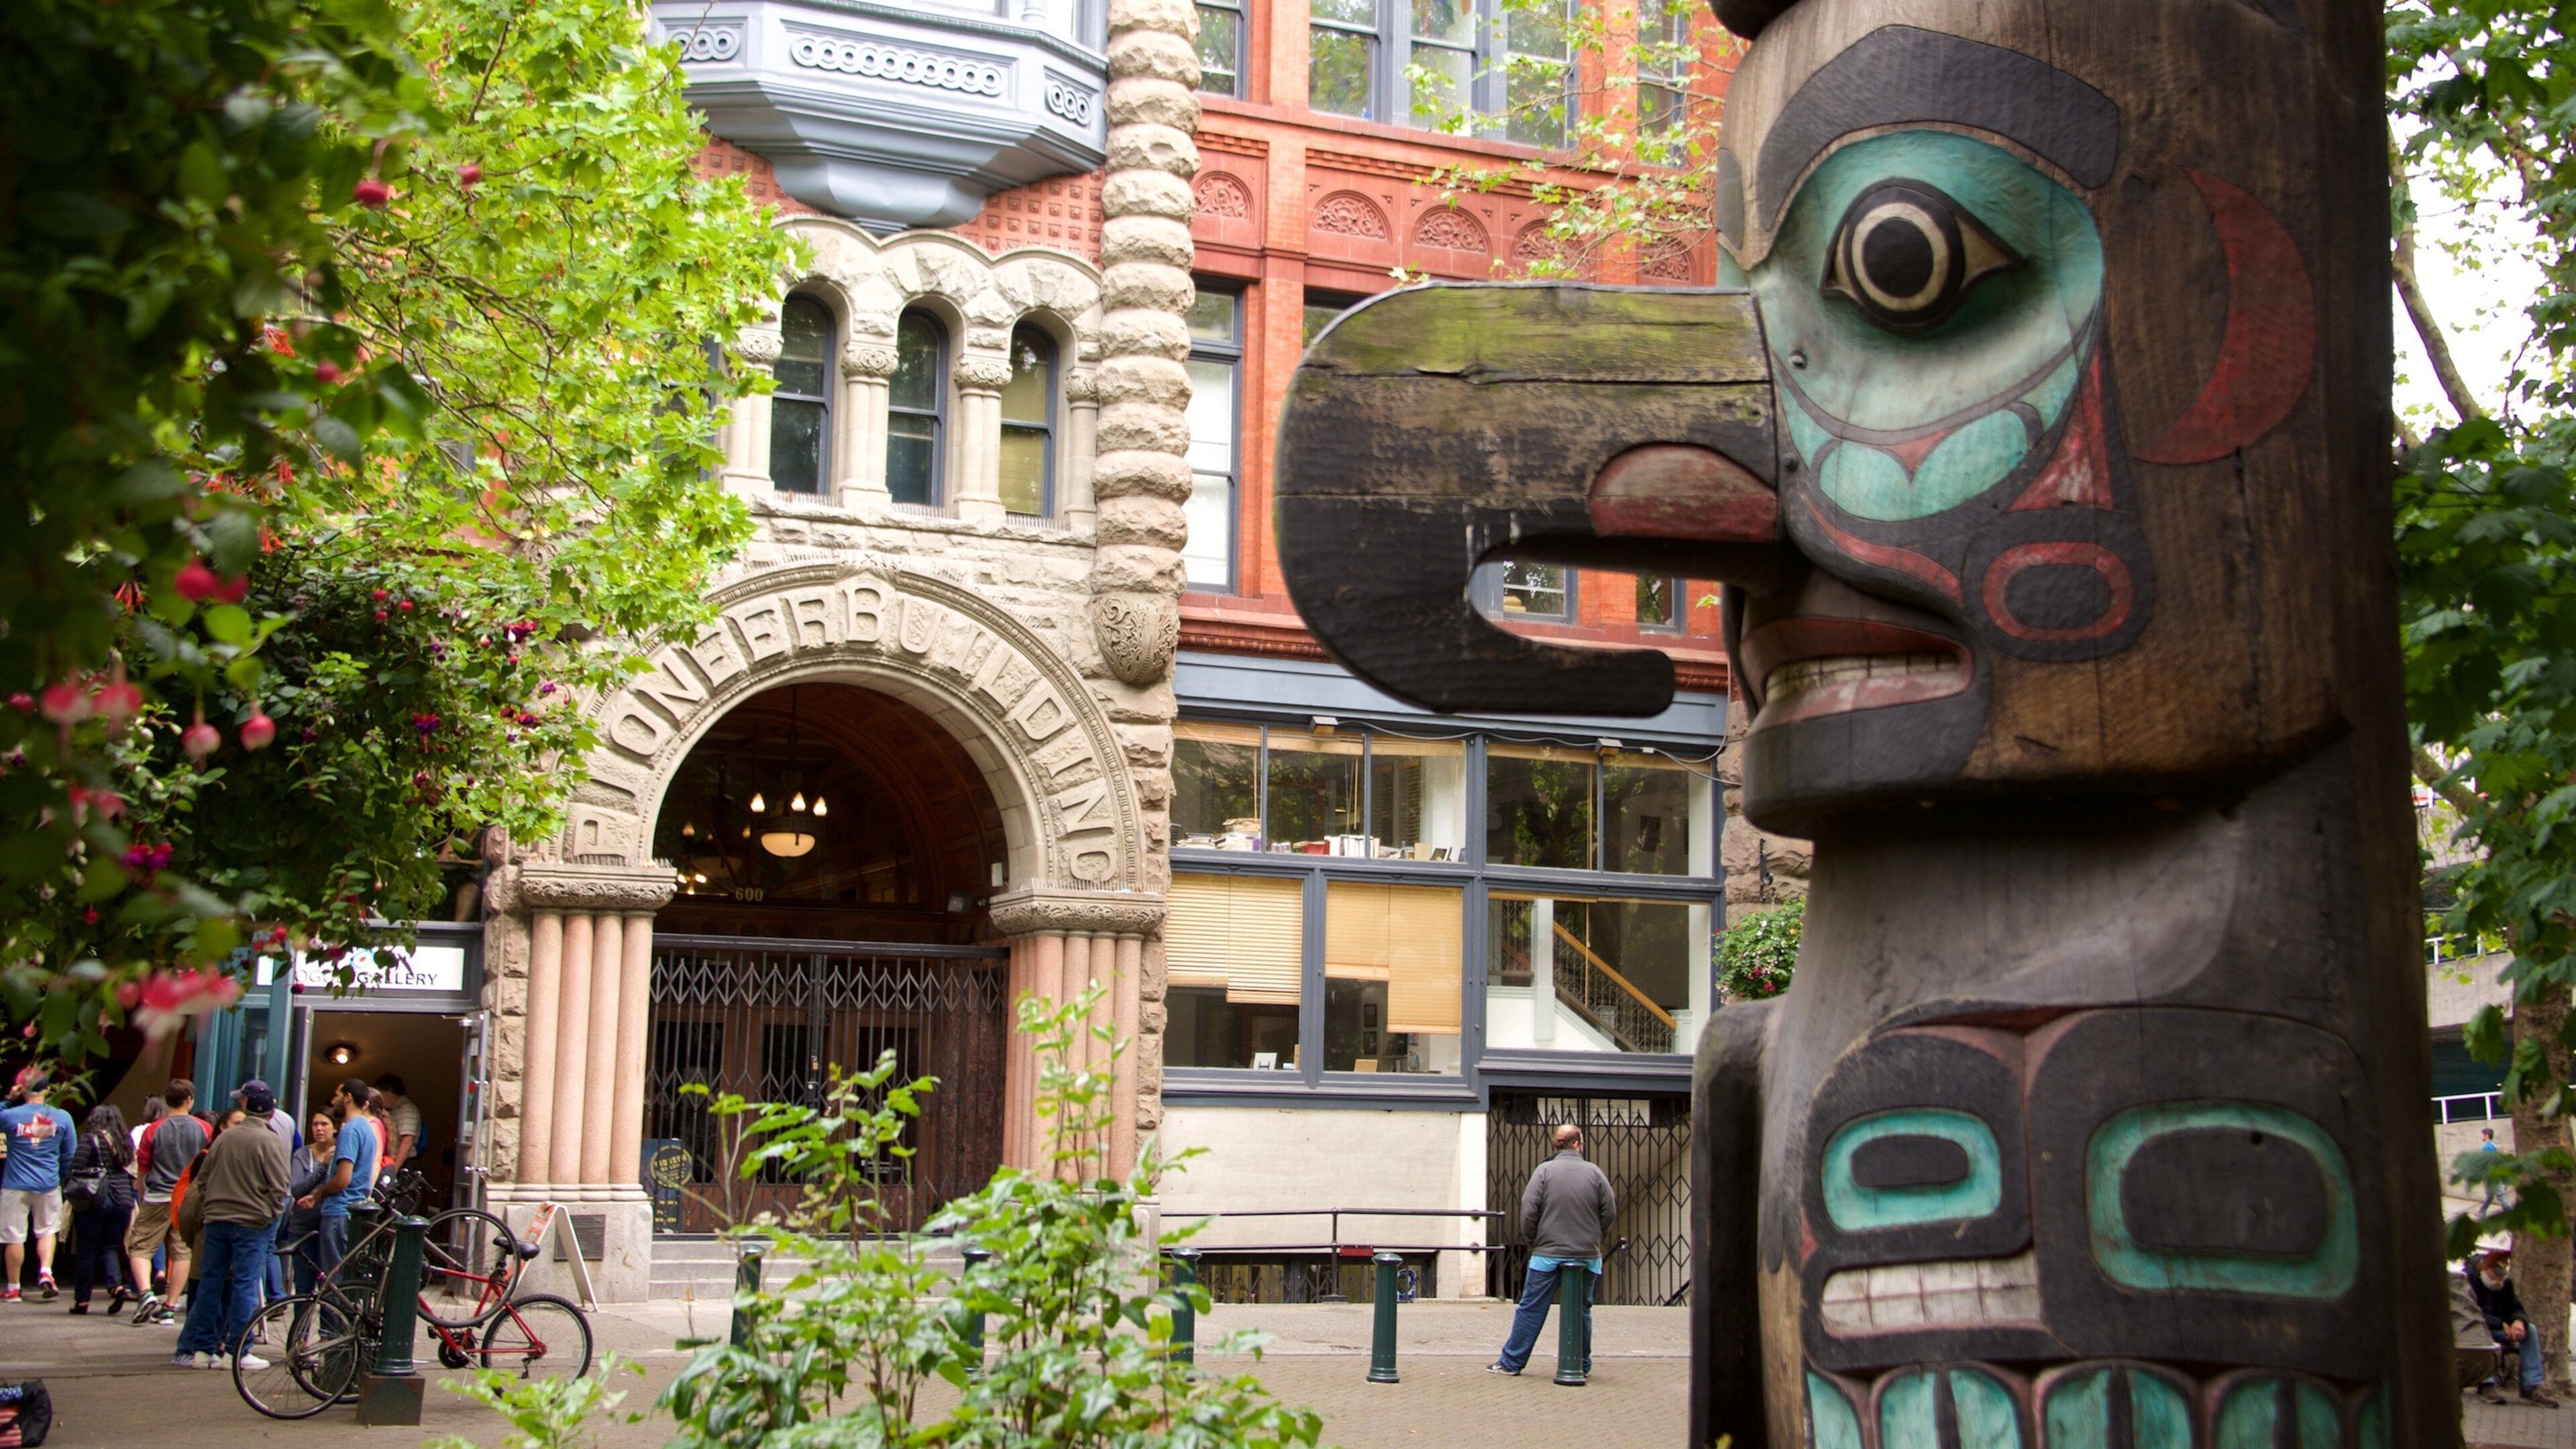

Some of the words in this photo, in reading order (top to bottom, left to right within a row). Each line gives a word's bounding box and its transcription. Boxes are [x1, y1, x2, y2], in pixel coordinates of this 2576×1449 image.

[573, 592, 837, 857] PIONEER
[843, 582, 1118, 882] BUILDING
[735, 887, 763, 902] 600
